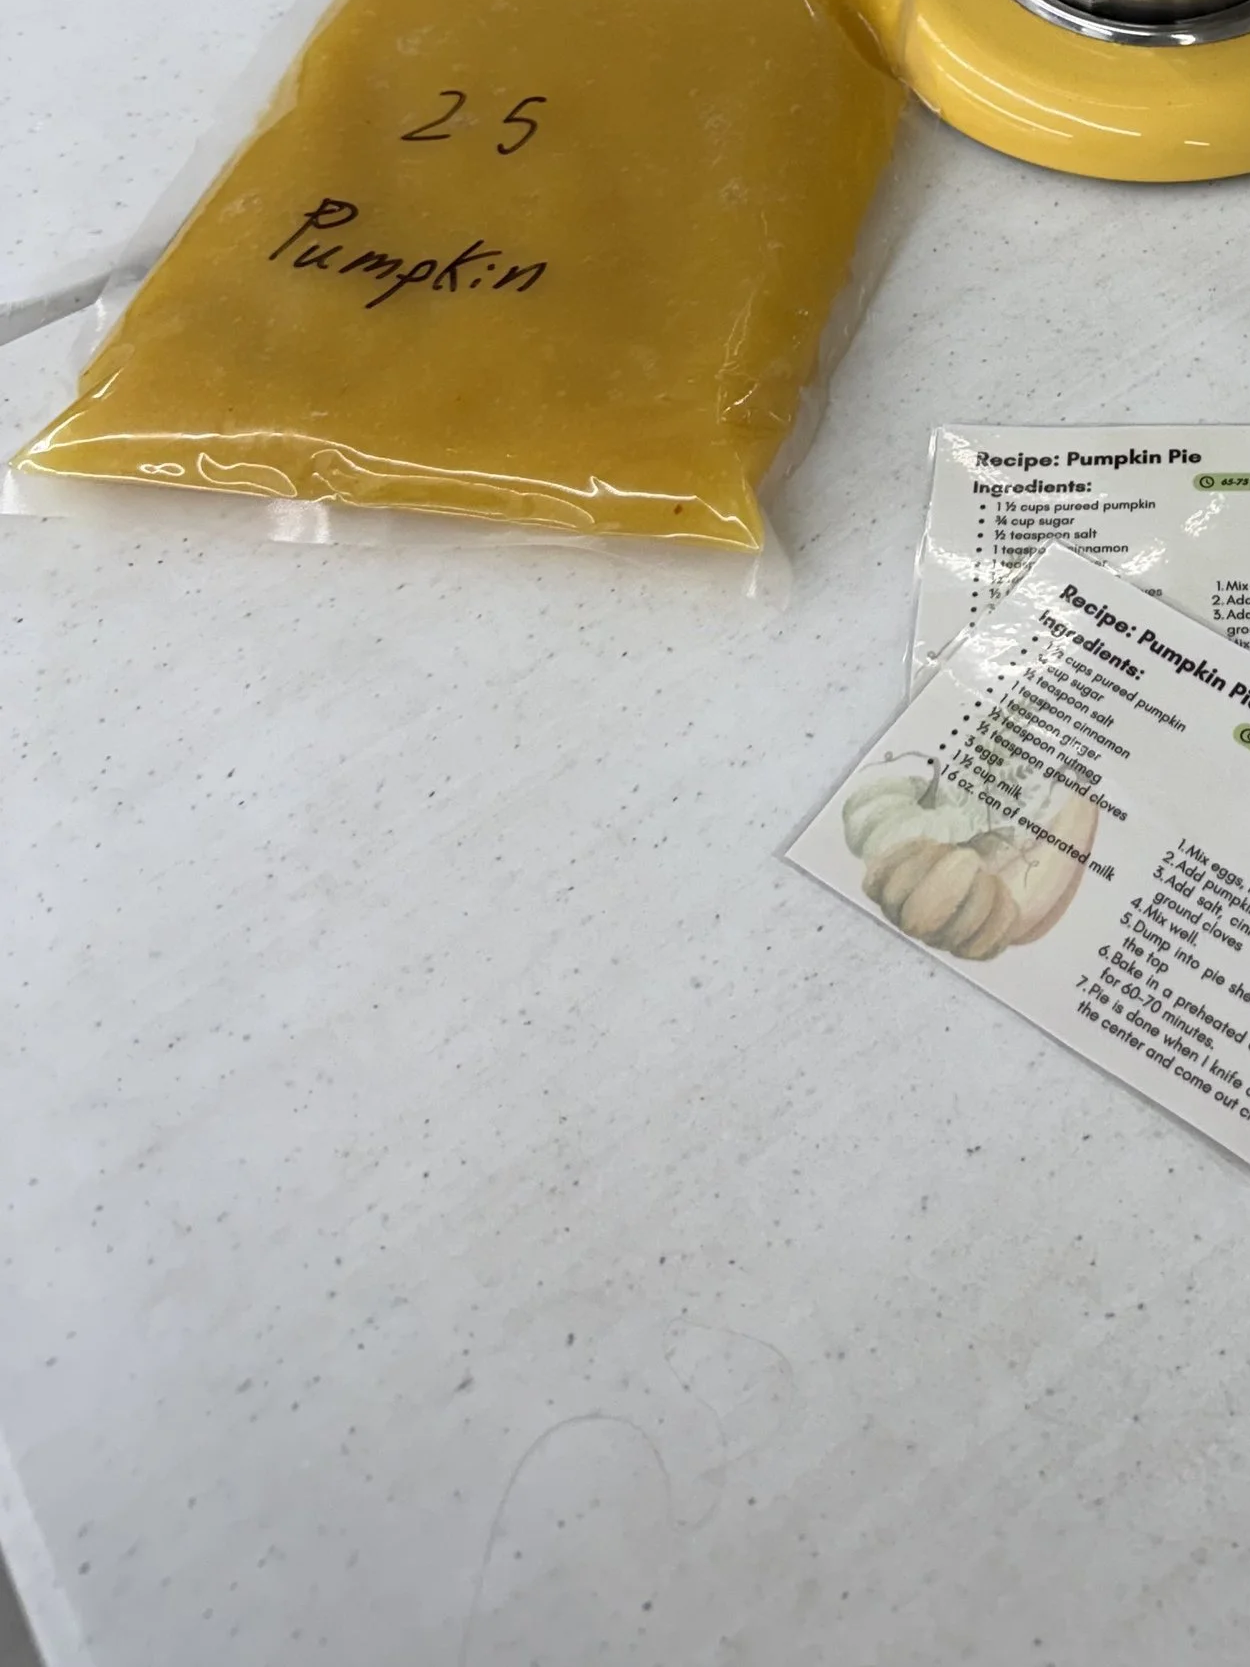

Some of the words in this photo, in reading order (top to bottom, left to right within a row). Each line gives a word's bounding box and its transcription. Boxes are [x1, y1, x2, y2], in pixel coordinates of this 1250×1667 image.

[975, 451, 1060, 472] Recipe:
[1066, 448, 1162, 470] Pumpkin
[1168, 448, 1202, 464] Pie
[973, 479, 1092, 498] Ingredients:
[1020, 504, 1051, 513] cups
[1053, 500, 1099, 513] pureed
[1103, 498, 1156, 513] pumpkin
[1009, 526, 1071, 541] teaspoon
[1074, 527, 1098, 540] salt
[1010, 518, 1035, 527] cup
[1038, 517, 1075, 527] sugar
[1037, 608, 1145, 681] Ingredients:
[1058, 583, 1136, 638] Recipe:
[1136, 628, 1226, 691] Pumpkin
[1035, 675, 1089, 714] teaspoon
[1089, 710, 1114, 728] salt
[1064, 656, 1093, 677] cups
[1090, 672, 1139, 702] pureed
[1133, 698, 1186, 732] pumpkin
[1069, 678, 1104, 702] sugar
[1005, 698, 1060, 737] teaspoon
[1058, 733, 1101, 761] ginger
[1017, 685, 1072, 723] teaspoon
[1072, 720, 1130, 759] cinnamon
[963, 734, 976, 747] 3
[974, 743, 1004, 766] eggs
[989, 729, 1044, 770] teaspoon
[1042, 765, 1091, 797] ground
[1088, 793, 1127, 821] cloves
[1000, 714, 1055, 755] teaspoon
[1055, 751, 1102, 785] nutmeg
[972, 765, 996, 785] cup
[994, 777, 1022, 801] milk
[957, 778, 974, 795] oz.
[977, 787, 1001, 810] can
[1002, 806, 1020, 819] of
[1017, 816, 1091, 865] evaporated
[1087, 860, 1115, 881] milk
[1210, 862, 1244, 890] eggs,
[1152, 891, 1203, 925] ground
[1201, 921, 1243, 952] cloves
[1169, 921, 1199, 947] well.
[1196, 895, 1222, 923] salt,
[1121, 936, 1144, 957] the
[1145, 951, 1169, 973] top
[1173, 946, 1200, 969] into
[1200, 967, 1225, 985] pie
[1099, 966, 1121, 987] for
[1120, 982, 1162, 1013] 60-70
[1160, 1010, 1213, 1050] minutes.
[1145, 974, 1159, 990] in
[1161, 987, 1173, 999] a
[1172, 995, 1248, 1044] preheated
[1076, 1000, 1099, 1022] the
[1100, 1018, 1145, 1050] center
[1145, 1047, 1176, 1069] and
[1173, 1065, 1212, 1094] come
[1213, 1090, 1239, 1110] out
[1111, 999, 1124, 1014] is
[1125, 1008, 1160, 1037] done
[1162, 1033, 1199, 1062] when
[1208, 1058, 1243, 1089] knife
